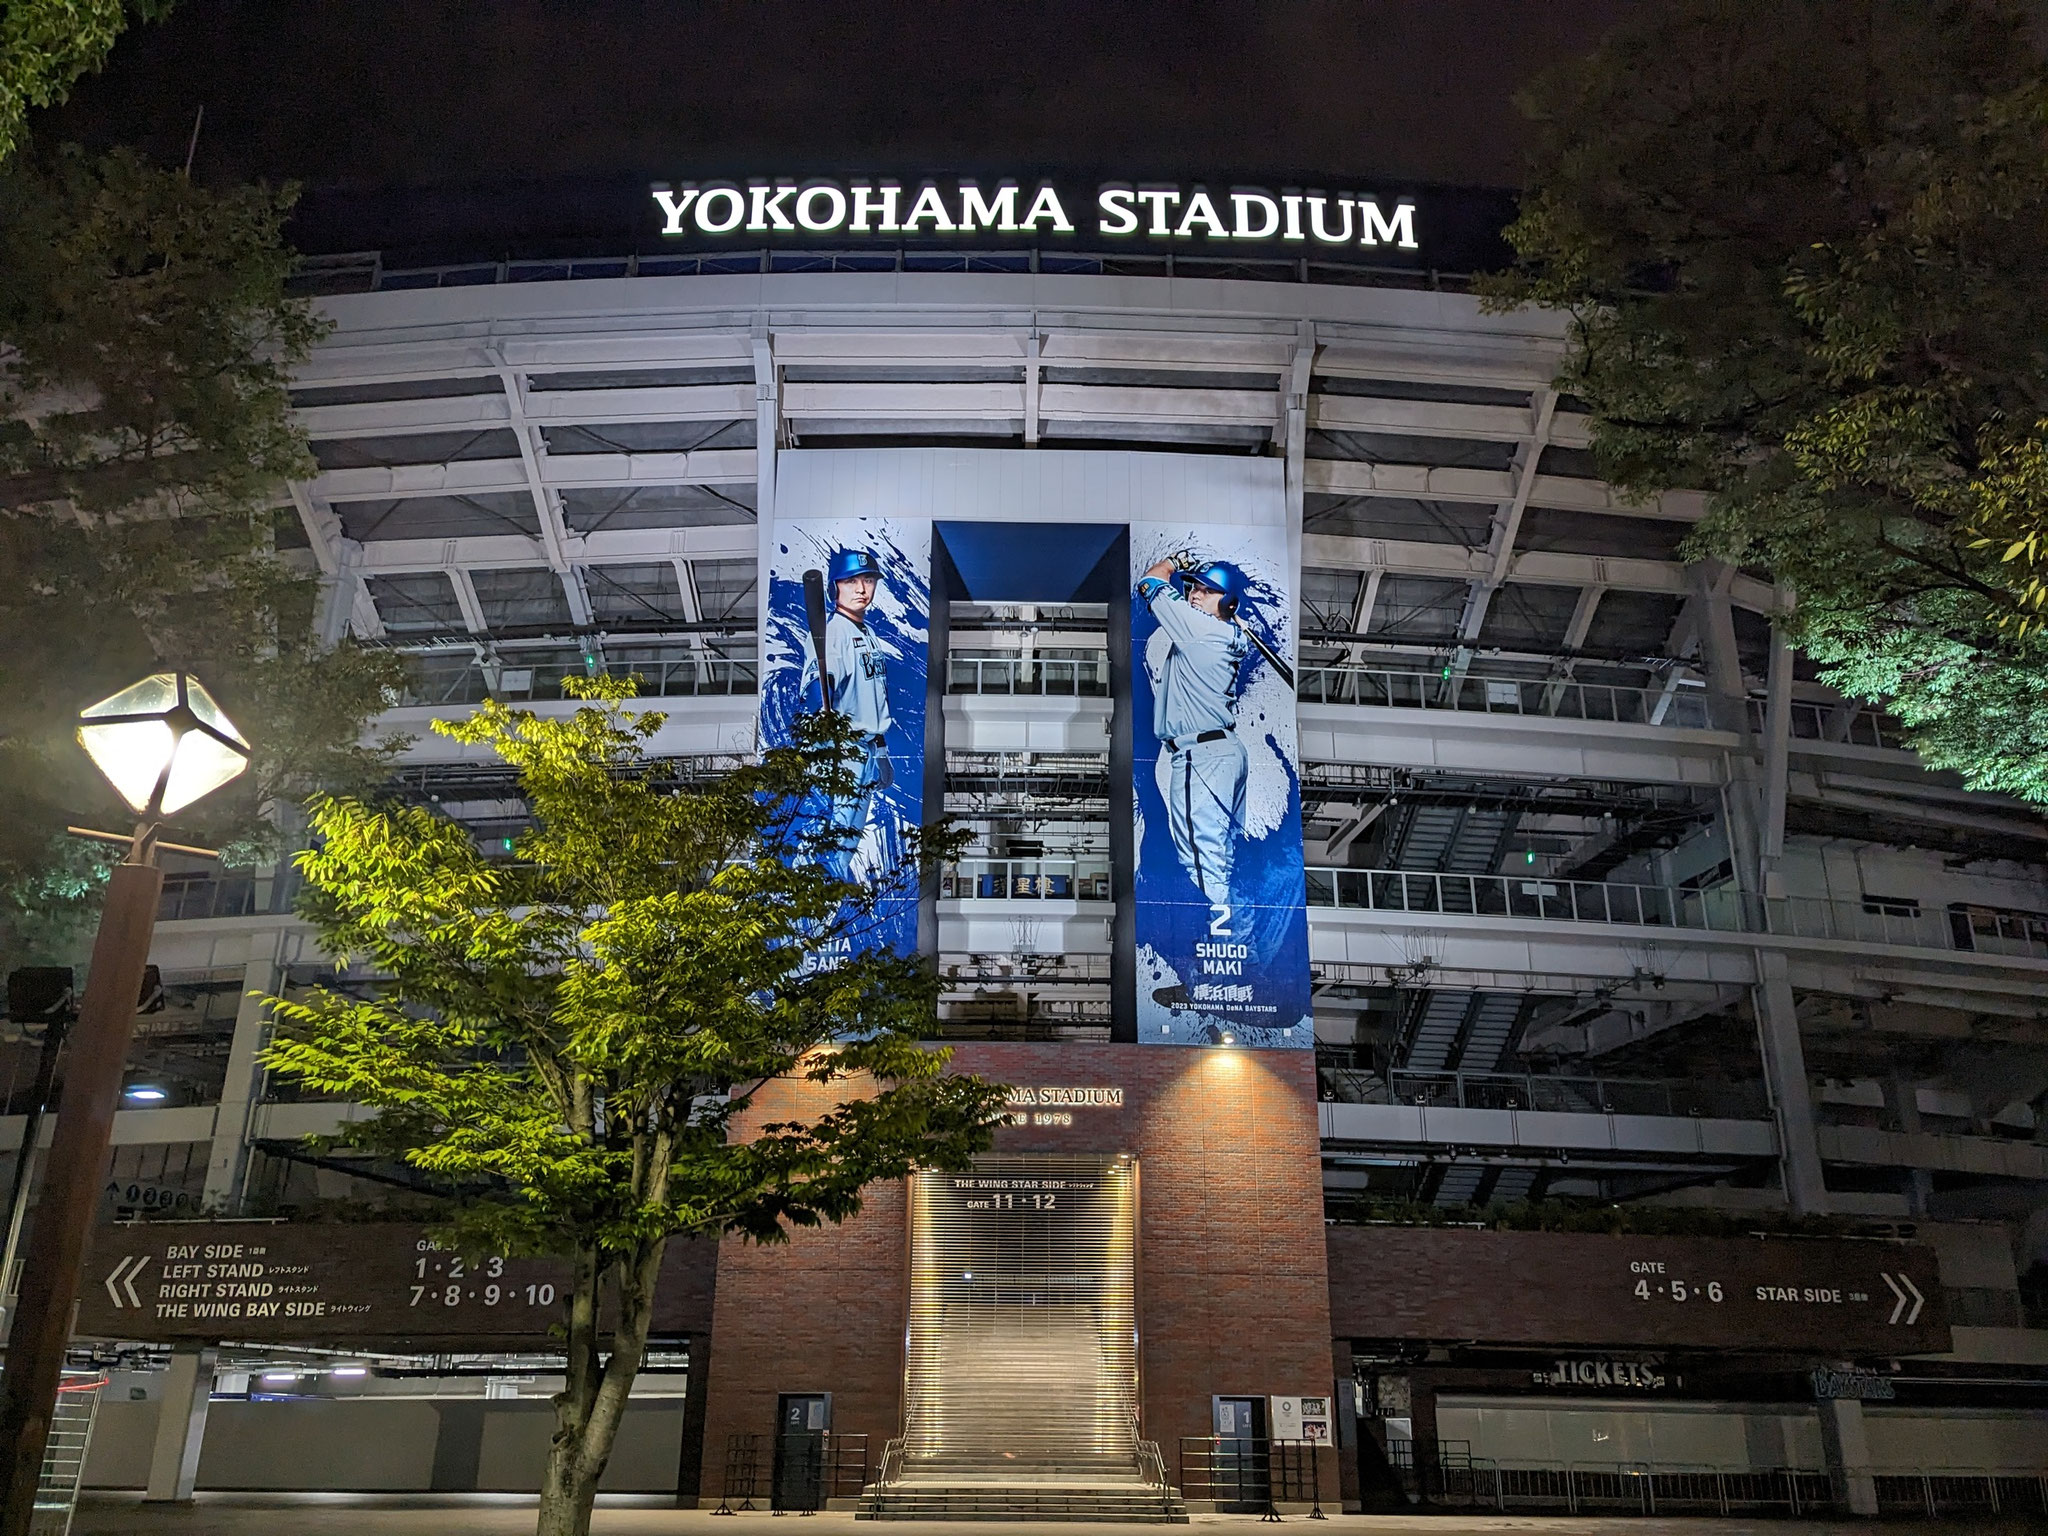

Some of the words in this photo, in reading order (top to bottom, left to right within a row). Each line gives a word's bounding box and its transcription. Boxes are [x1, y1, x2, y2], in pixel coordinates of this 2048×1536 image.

[652, 186, 1075, 235] YOKOHAMA
[1098, 189, 1419, 249] STADIUM
[1209, 904, 1232, 936] 2
[1195, 943, 1248, 959] SHUGO
[1203, 960, 1242, 976] MAKI
[1170, 1002, 1188, 1010] 2023
[1189, 1003, 1224, 1011] YOKOHAMA
[1244, 1004, 1278, 1013] BAYSTARS
[1040, 1088, 1122, 1105] STADIUM
[1035, 1113, 1071, 1125] 1978
[954, 1179, 976, 1188] THE
[978, 1180, 1008, 1189] WING
[1011, 1180, 1040, 1189] STAR
[1041, 1180, 1066, 1189] SIDE
[967, 1200, 989, 1208] GATE
[167, 1245, 200, 1259] BAY
[204, 1244, 243, 1258] SIDE
[163, 1265, 203, 1279] LEFT
[206, 1264, 264, 1278] STAND
[269, 1265, 309, 1274] レフトスタンド
[1630, 1261, 1666, 1274] GATE
[159, 1284, 211, 1298] RIGHT
[215, 1283, 273, 1297] STAND
[278, 1285, 319, 1294] ライトスタンド
[1756, 1286, 1799, 1302] STAR
[1804, 1288, 1842, 1303] SIDE
[156, 1304, 188, 1318] THE
[193, 1303, 241, 1317] WING
[246, 1303, 280, 1317] BAY
[285, 1302, 326, 1317] SIDE
[1554, 1360, 1654, 1386] TICKETS
[790, 1407, 801, 1420] 2
